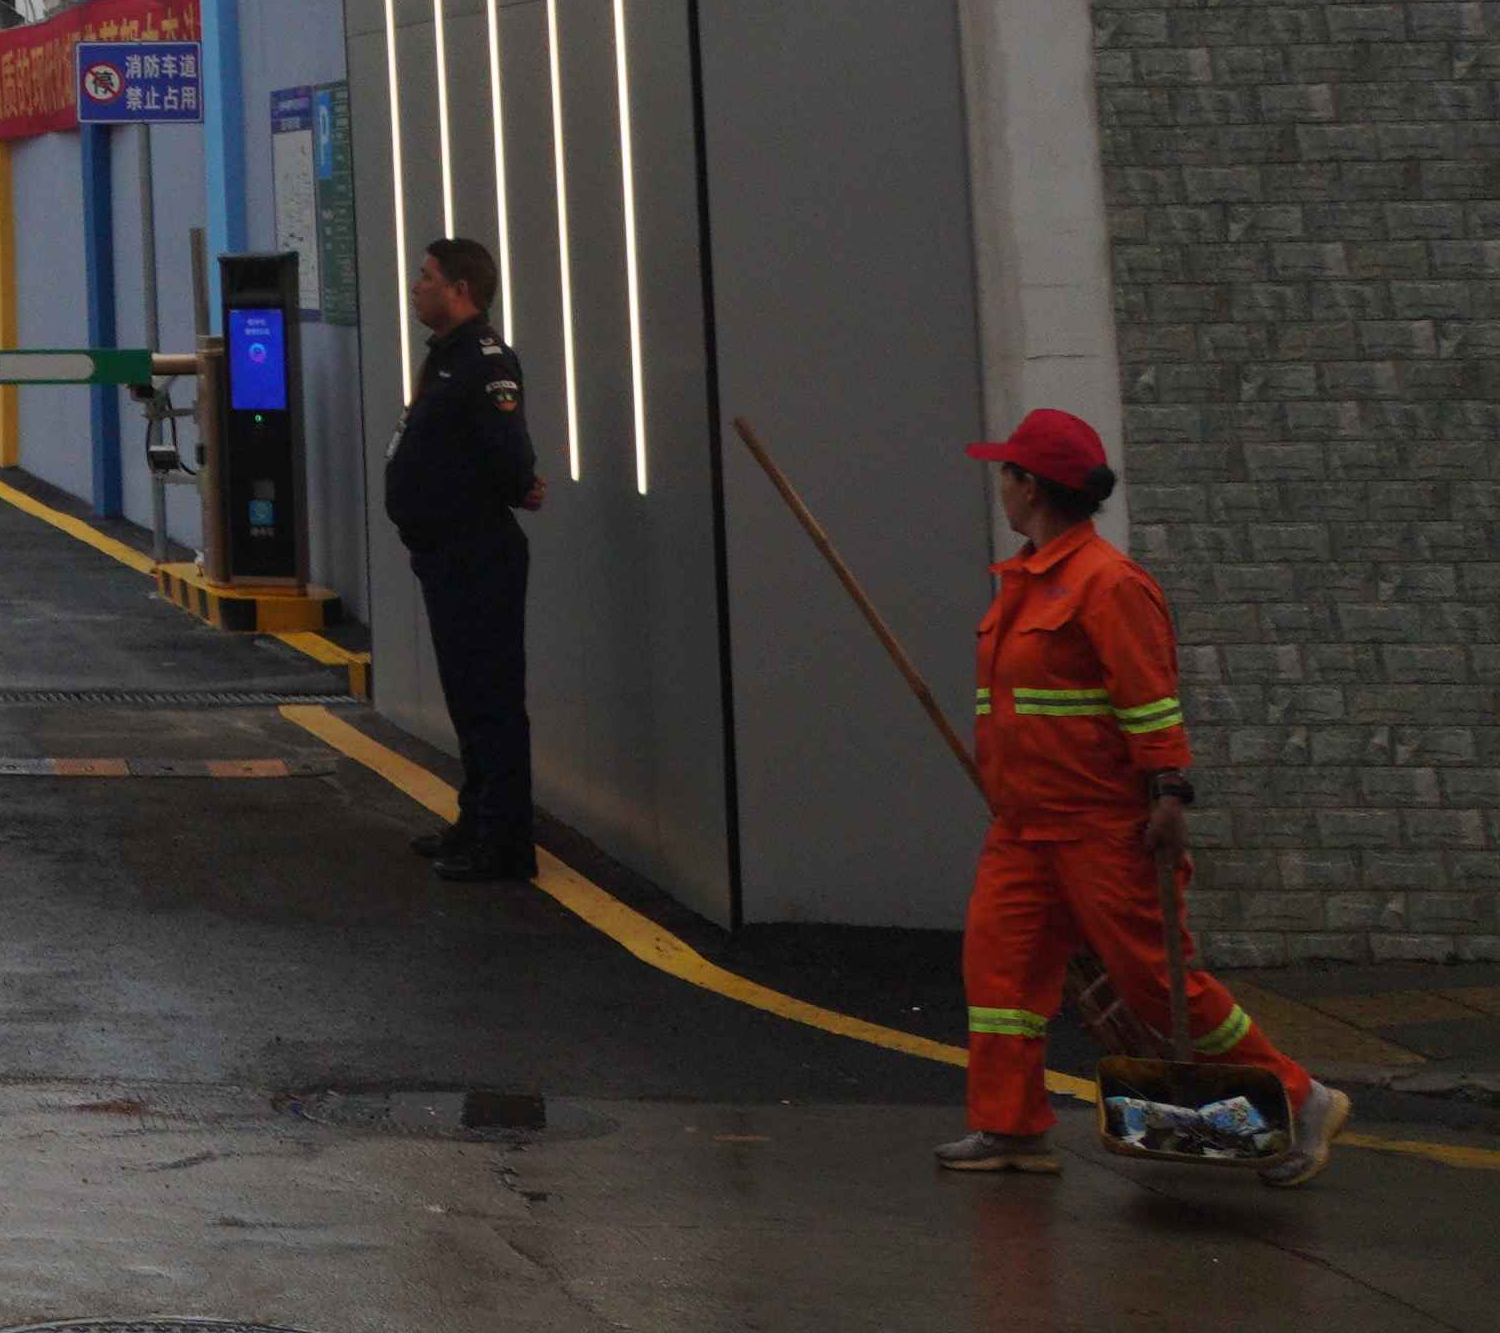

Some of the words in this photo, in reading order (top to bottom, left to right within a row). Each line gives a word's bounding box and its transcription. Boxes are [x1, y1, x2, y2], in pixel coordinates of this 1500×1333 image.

[125, 54, 197, 80] 消防车道
[125, 86, 197, 111] 禁止占用
